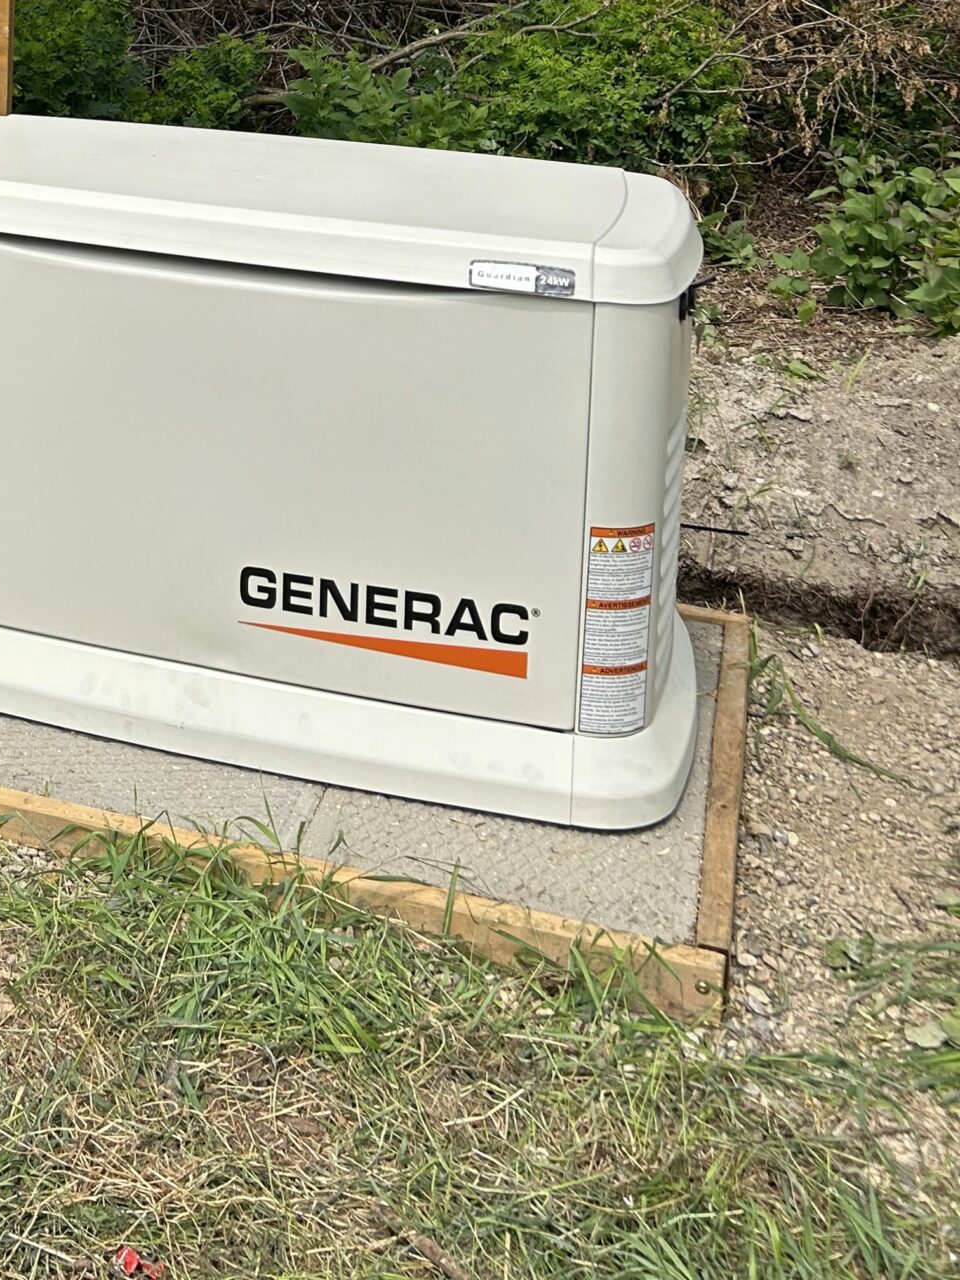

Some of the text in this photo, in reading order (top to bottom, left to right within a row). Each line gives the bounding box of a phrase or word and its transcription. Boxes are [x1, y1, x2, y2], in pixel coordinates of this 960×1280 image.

[477, 270, 570, 287] Guardian 24kW
[617, 528, 647, 536] WARNING
